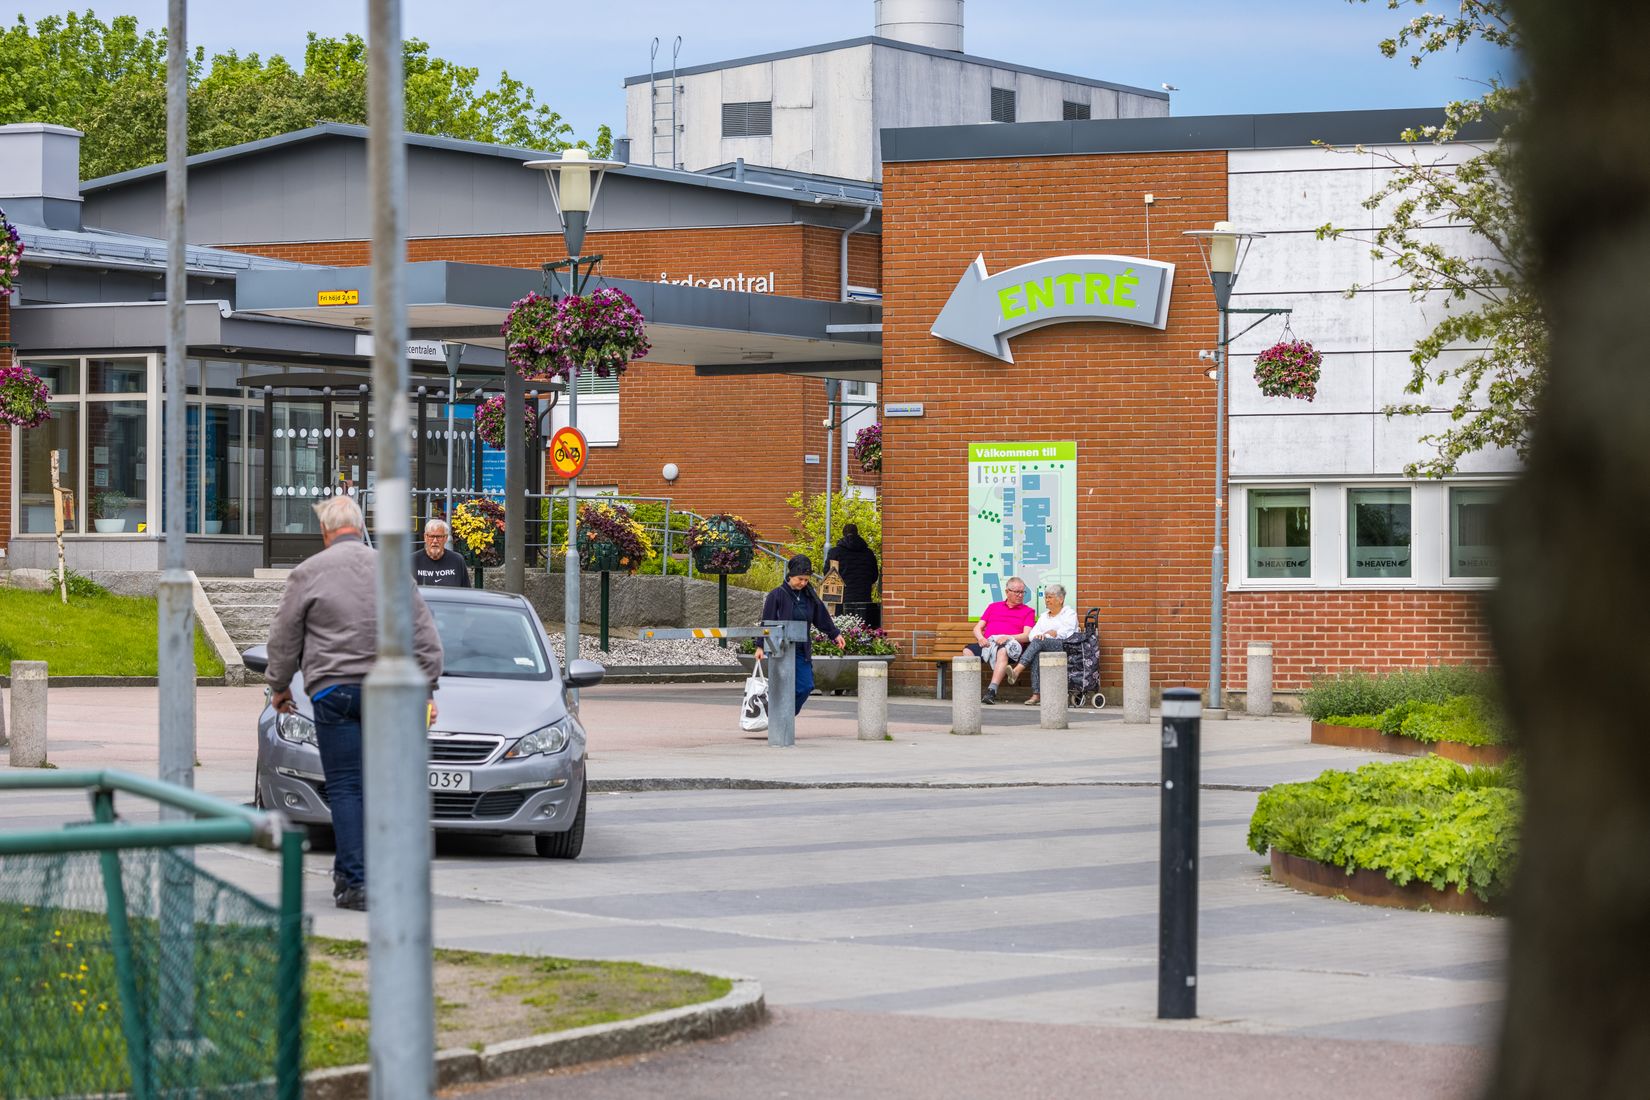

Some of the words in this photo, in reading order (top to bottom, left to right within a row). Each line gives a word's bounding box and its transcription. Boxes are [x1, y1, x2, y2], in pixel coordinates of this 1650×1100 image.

[649, 272, 775, 293] ådcentral
[997, 268, 1140, 320] ENTRÉ
[405, 345, 437, 356] centralen
[976, 448, 1040, 458] Välkommen
[1042, 447, 1057, 457] till
[983, 465, 1017, 475] TUVE
[985, 475, 1017, 485] torg
[1264, 560, 1297, 568] HEAVEN
[1364, 560, 1398, 568] HEAVEN
[417, 569, 435, 577] NEW
[435, 568, 456, 577] YORK
[429, 771, 464, 788] 039
